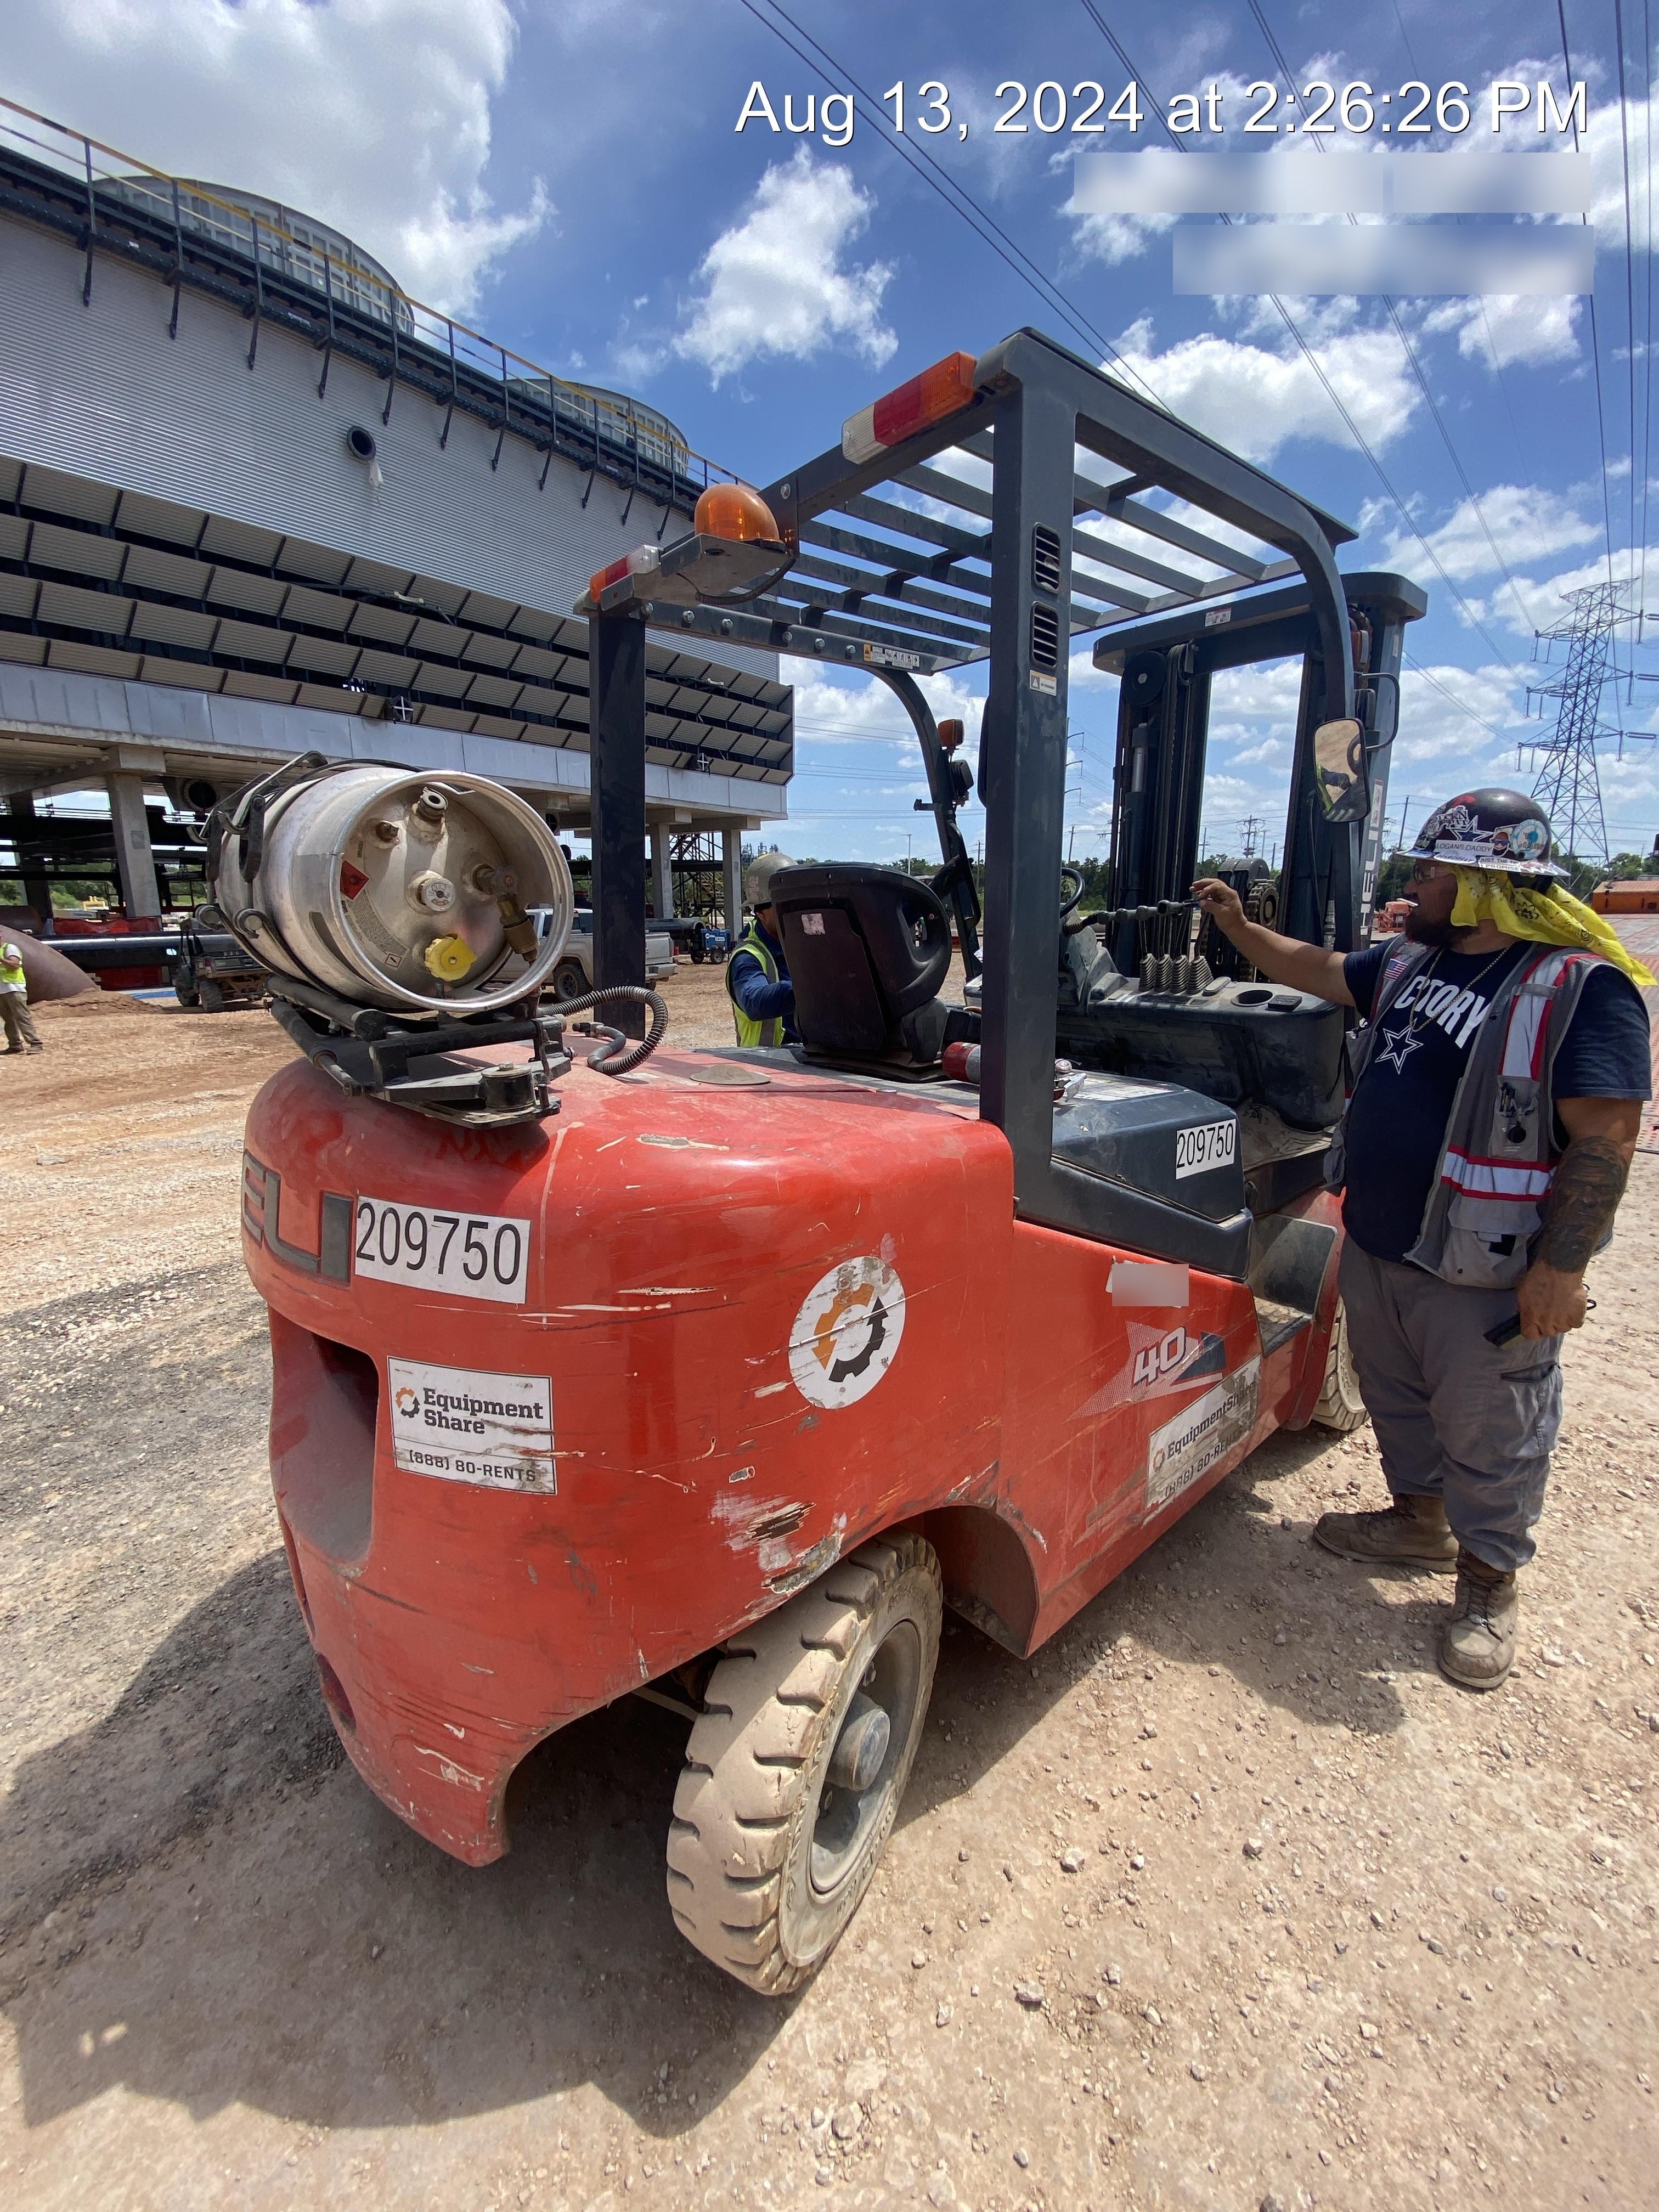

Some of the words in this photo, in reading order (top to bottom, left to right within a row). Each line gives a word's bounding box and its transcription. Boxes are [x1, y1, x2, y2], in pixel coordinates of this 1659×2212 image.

[1360, 830, 1379, 936] HELI
[1176, 1122, 1234, 1169] 209750
[356, 1201, 521, 1285] 209750
[1133, 1326, 1186, 1385] 40
[422, 1387, 544, 1420] Equipment
[424, 1408, 486, 1435] Share
[409, 1449, 449, 1470] (888)
[455, 1459, 537, 1482] 80-RENTS
